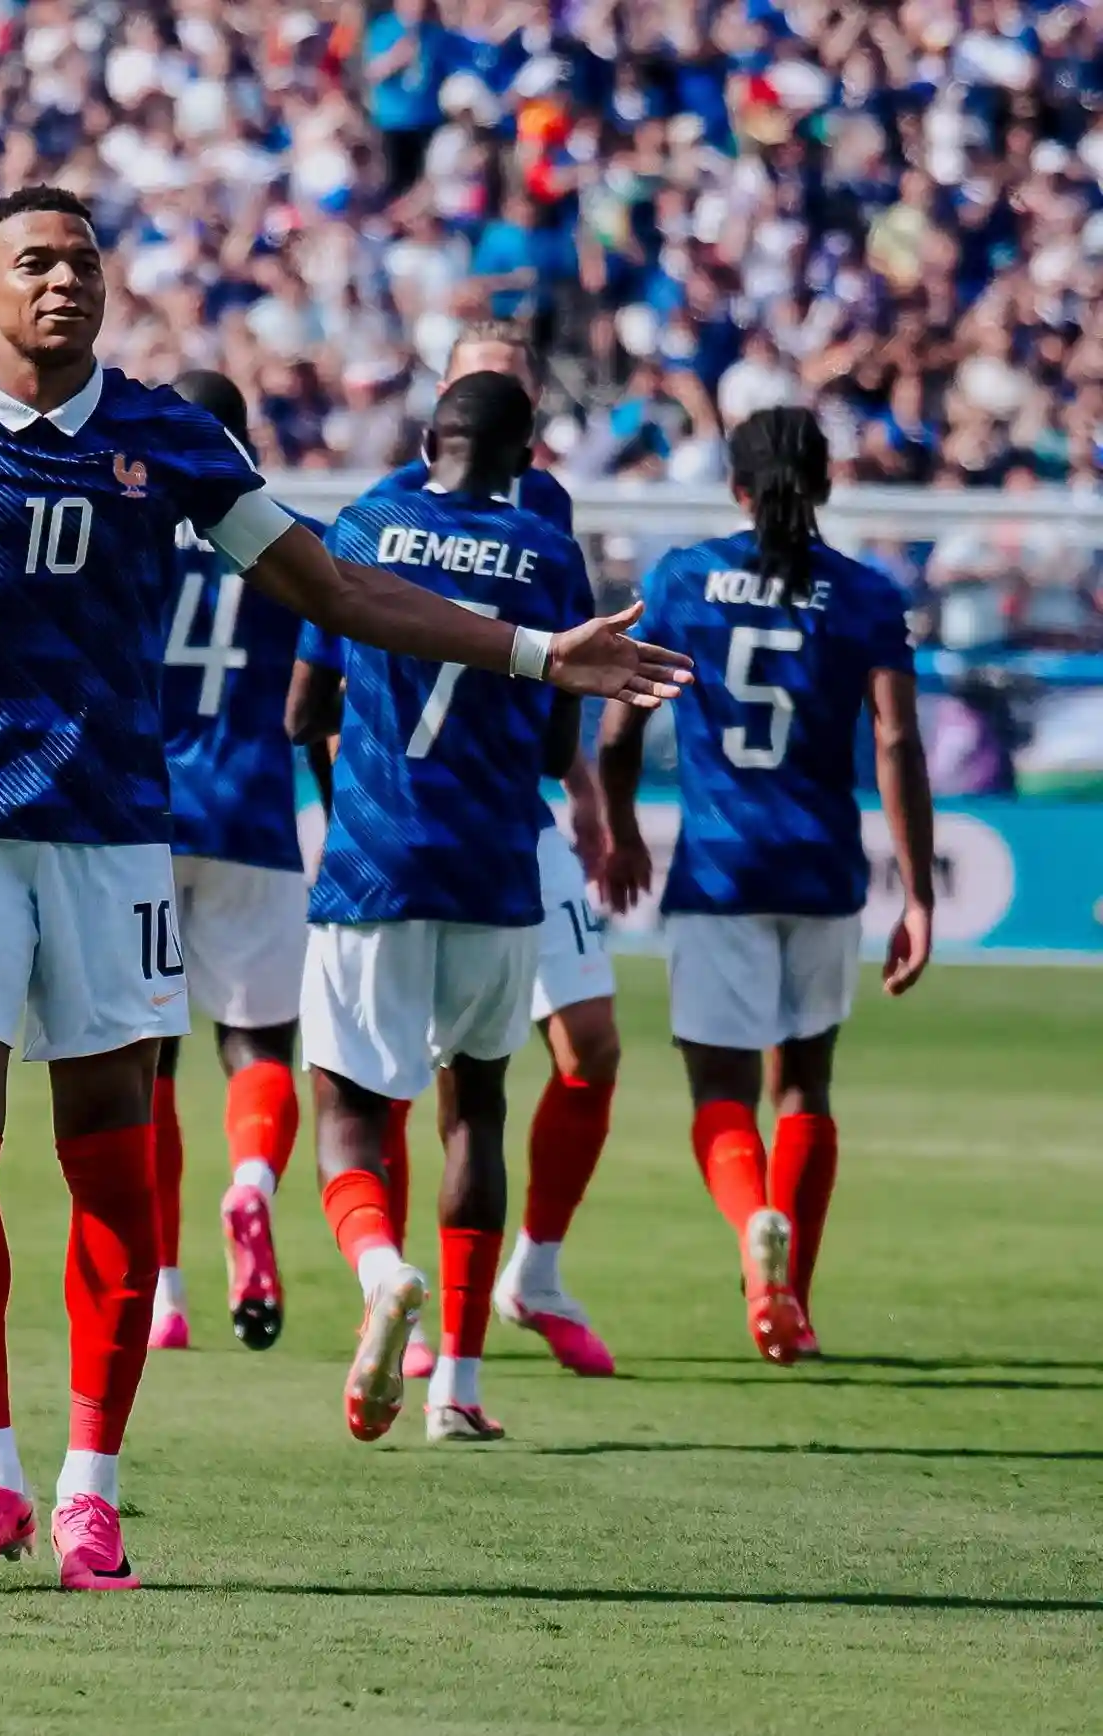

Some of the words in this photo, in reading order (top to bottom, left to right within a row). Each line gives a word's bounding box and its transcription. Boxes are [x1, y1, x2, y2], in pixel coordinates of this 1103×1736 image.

[25, 497, 93, 574] 10
[377, 526, 539, 584] DEMBELE
[163, 572, 247, 715] 4
[405, 597, 500, 759] 7
[722, 626, 804, 769] 5
[133, 900, 184, 980] 10
[560, 900, 609, 954] 14
